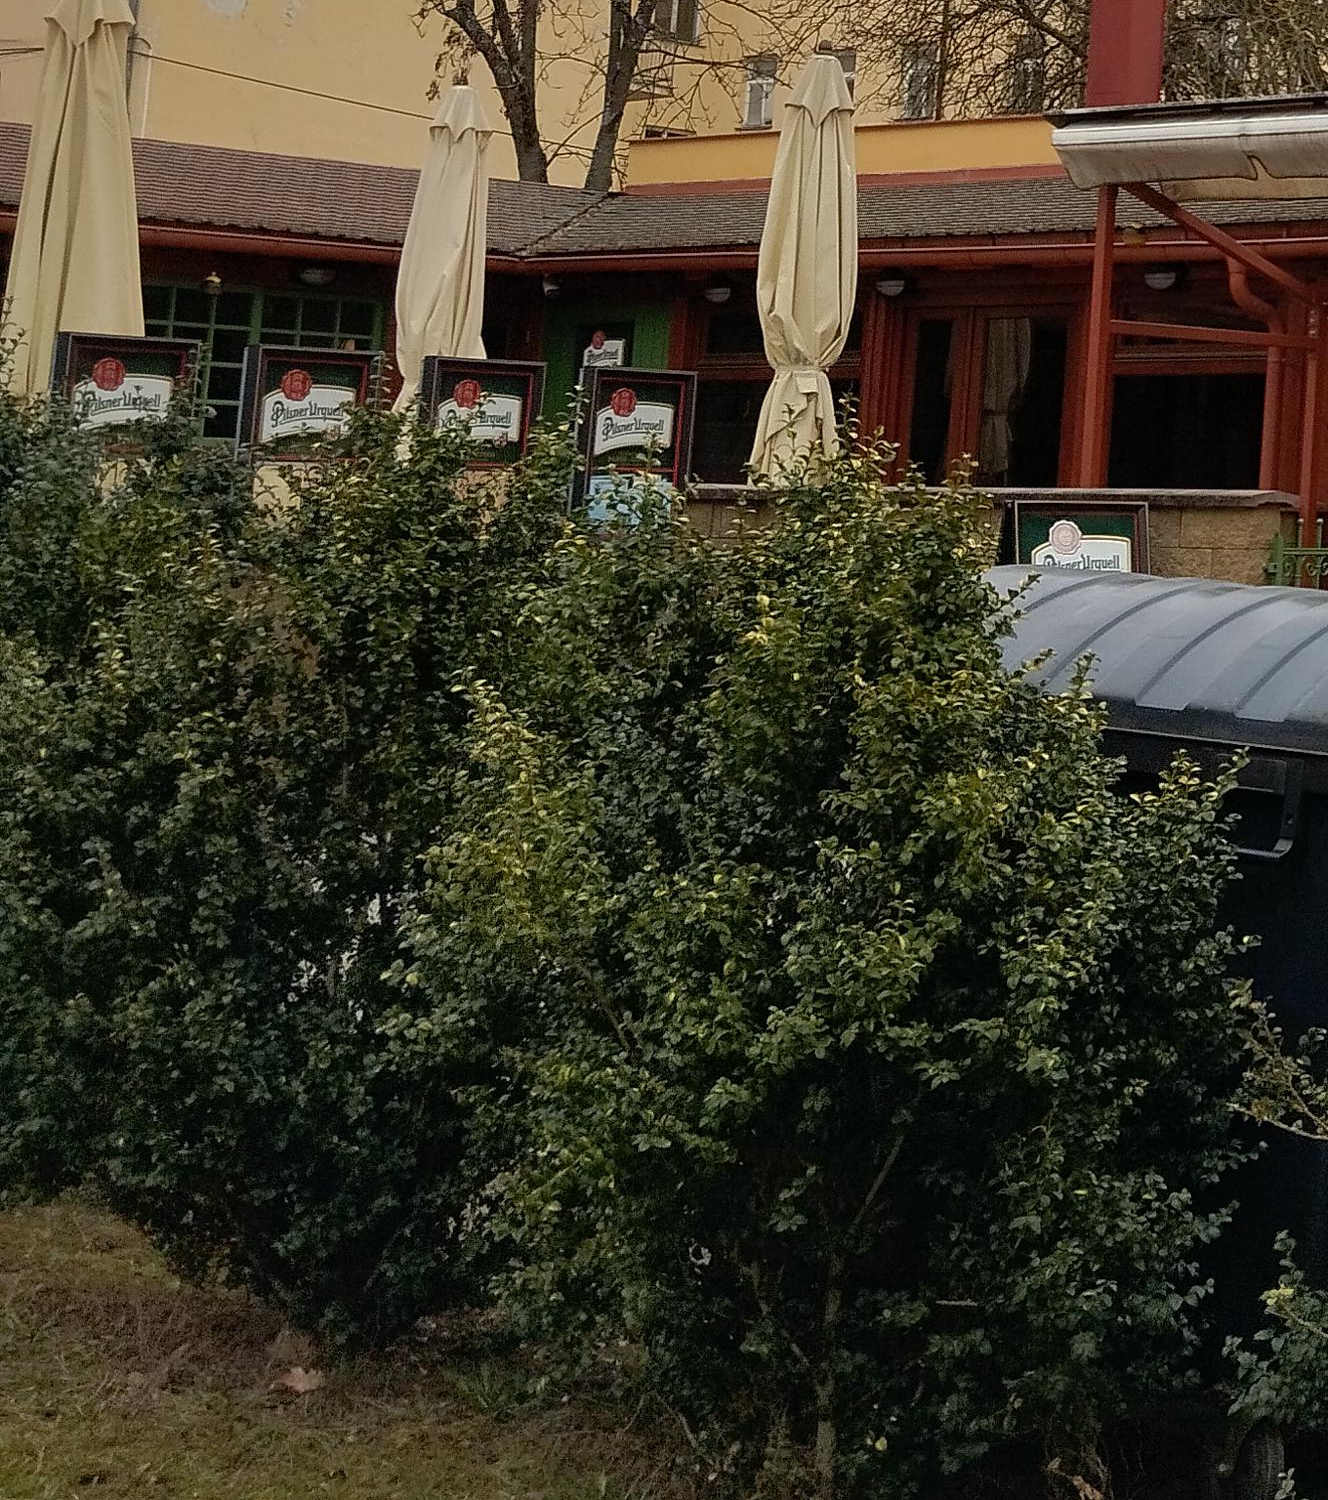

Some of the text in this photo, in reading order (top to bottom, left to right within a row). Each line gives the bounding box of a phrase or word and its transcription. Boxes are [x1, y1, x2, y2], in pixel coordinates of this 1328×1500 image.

[271, 400, 311, 429] Pilsner
[602, 417, 664, 441] Pilsner Urquell
